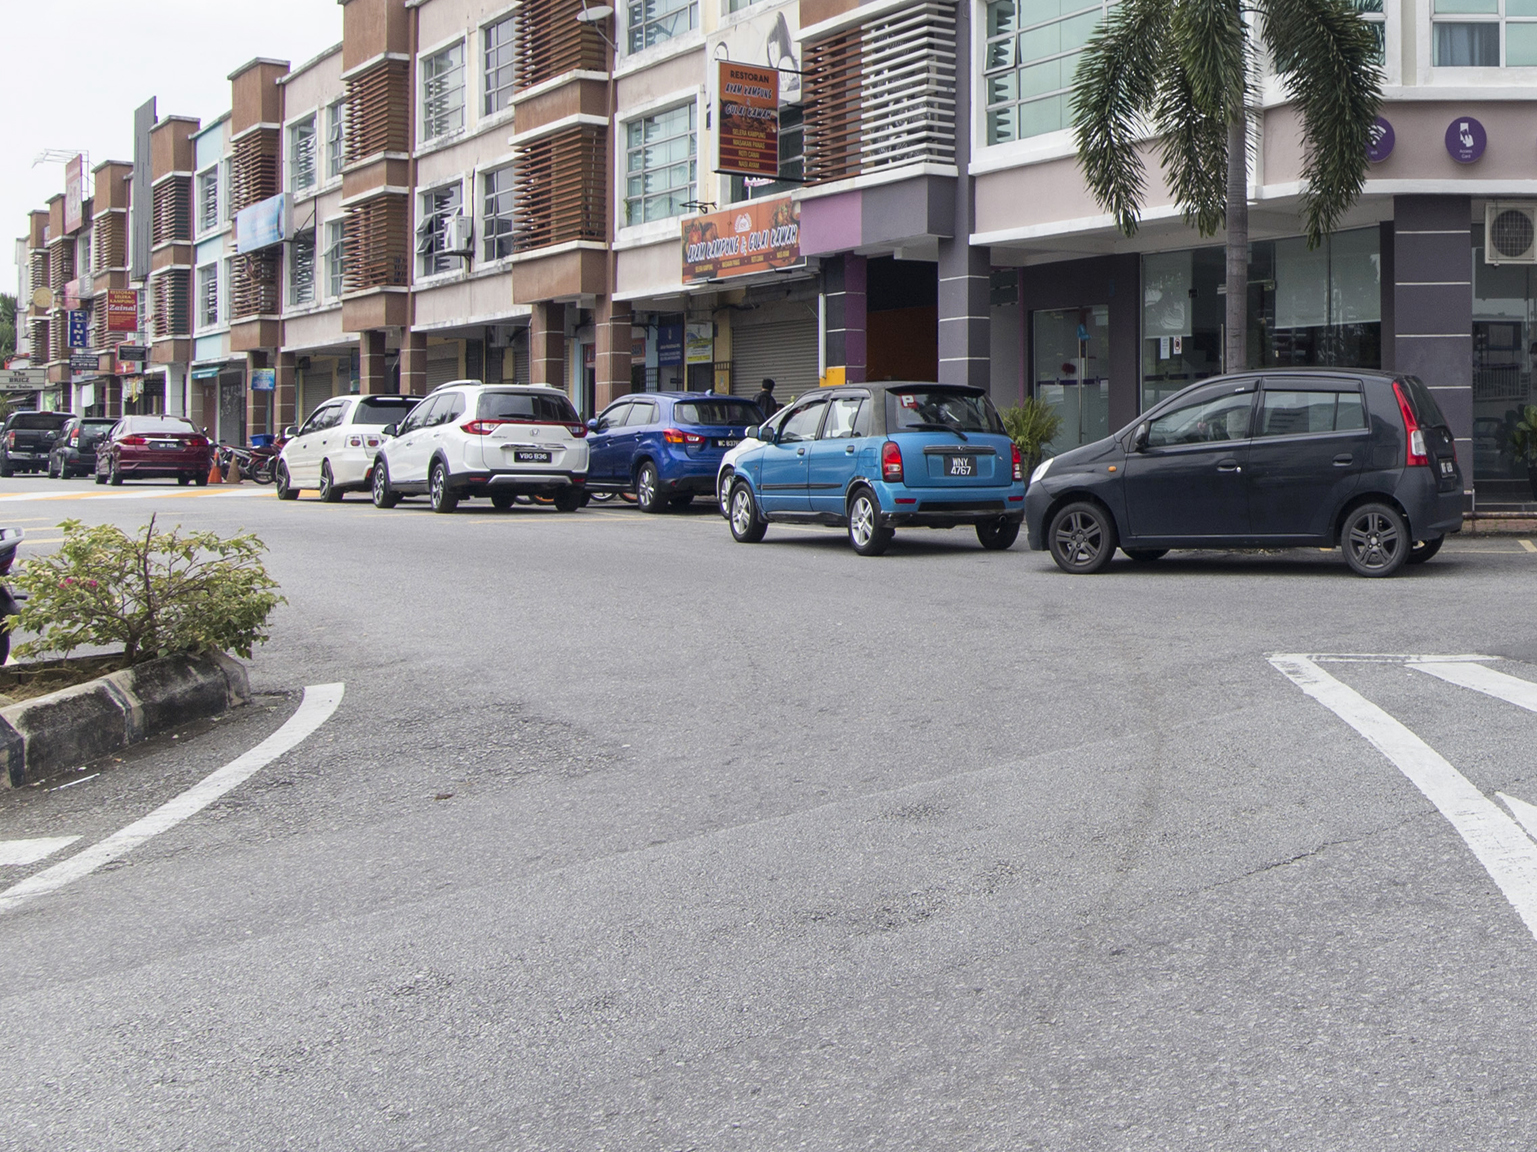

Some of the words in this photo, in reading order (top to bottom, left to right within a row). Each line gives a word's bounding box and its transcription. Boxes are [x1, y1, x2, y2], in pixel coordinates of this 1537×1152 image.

[730, 70, 770, 84] RESTORAN
[725, 83, 743, 95] AYAM
[743, 85, 772, 100] KAMPUNG
[725, 103, 746, 117] GULAI
[687, 243, 706, 263] AYAM
[706, 235, 739, 260] KAMPUNG
[748, 229, 770, 252] GULAI
[770, 224, 798, 247] KAWAH
[73, 312, 84, 346] KLINIK
[901, 395, 915, 407] P
[952, 457, 969, 467] WNY
[950, 465, 972, 475] 4767
